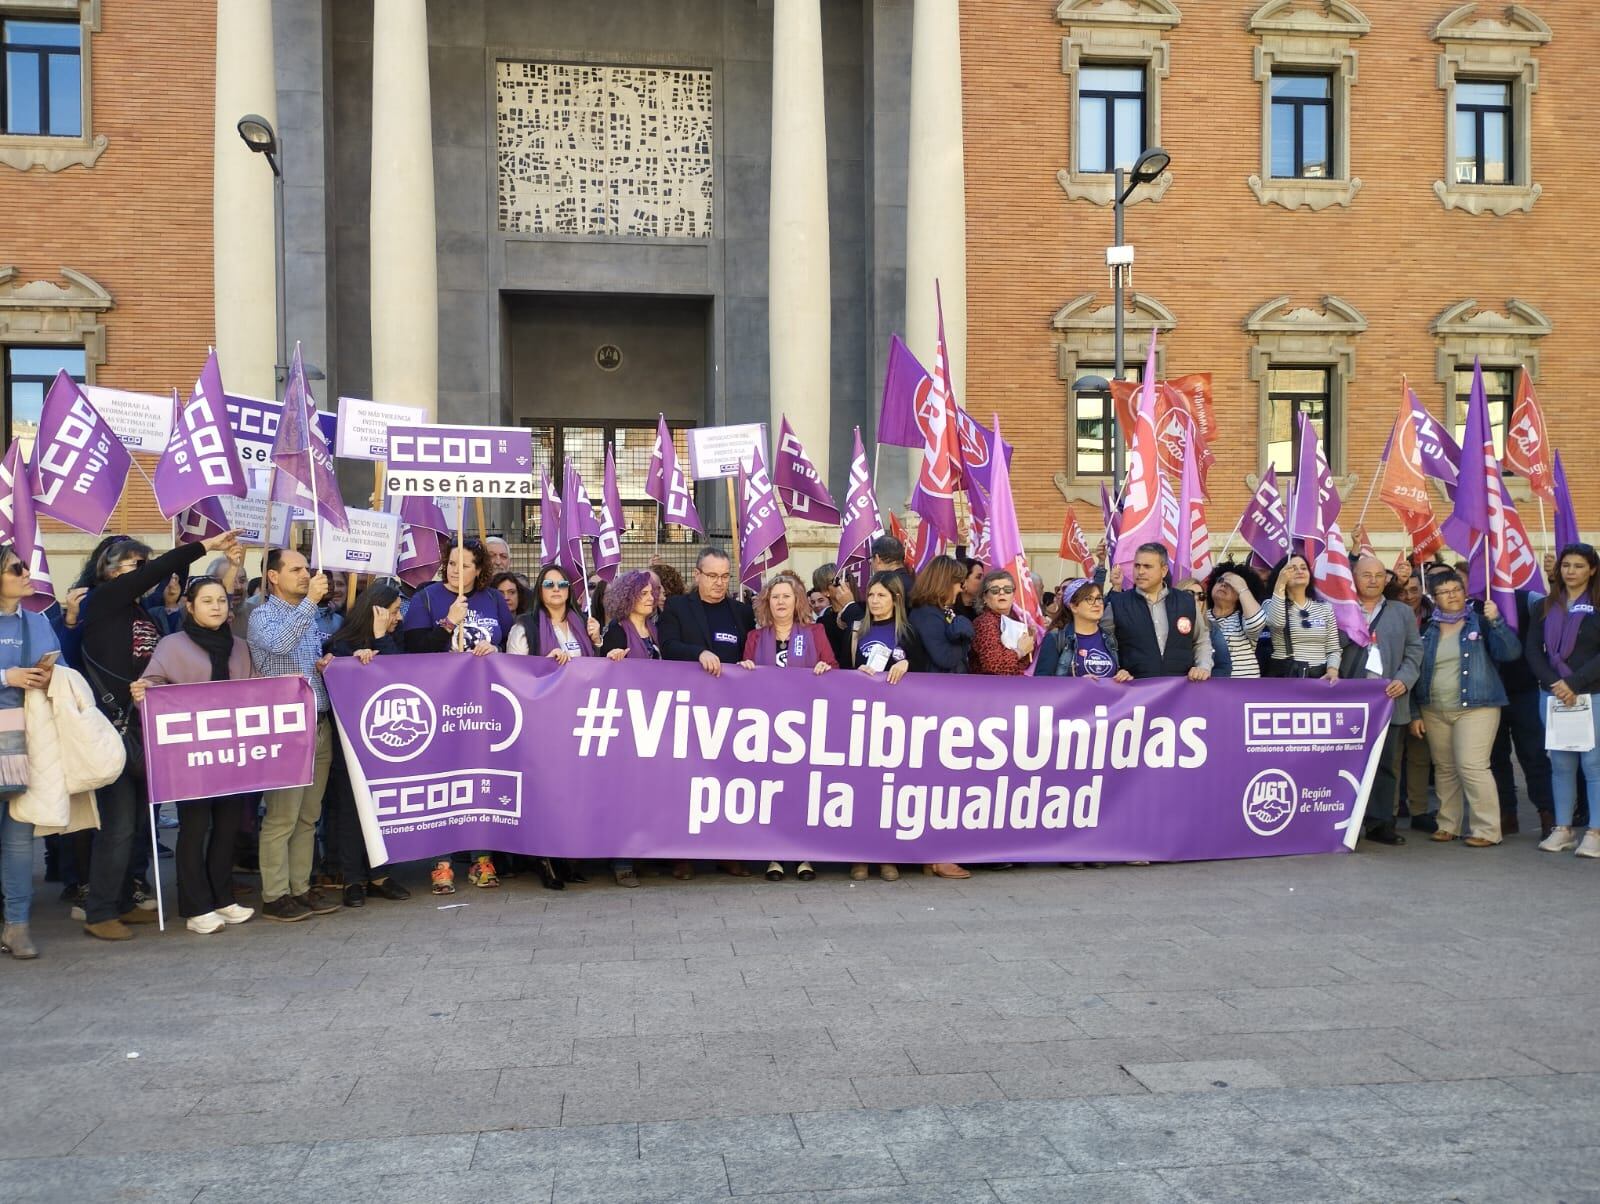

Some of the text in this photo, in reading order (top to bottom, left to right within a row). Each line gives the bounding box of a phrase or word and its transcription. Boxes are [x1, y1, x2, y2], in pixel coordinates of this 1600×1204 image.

[391, 436, 492, 465] CCOO
[72, 431, 113, 494] mujer
[388, 475, 532, 494] enseñanza
[374, 698, 421, 725] UGT
[442, 702, 483, 719] Región
[155, 702, 307, 745] CCOO
[442, 718, 502, 732] de Murcia
[572, 687, 1208, 771] #VivasLibresUnidas
[1252, 712, 1331, 735] CCOO
[187, 742, 283, 767] mujer
[1246, 745, 1284, 753] comisiones
[1285, 744, 1310, 752] obreras
[1311, 744, 1334, 753] Región
[1343, 743, 1363, 751] Murcia
[371, 779, 473, 816] CCOO
[1252, 780, 1288, 803] UGT
[1301, 786, 1332, 801] Región
[688, 771, 1103, 840] por la igualdad
[1300, 800, 1345, 812] de Murcia
[382, 813, 519, 836] isiones obreras Región de Murcia
